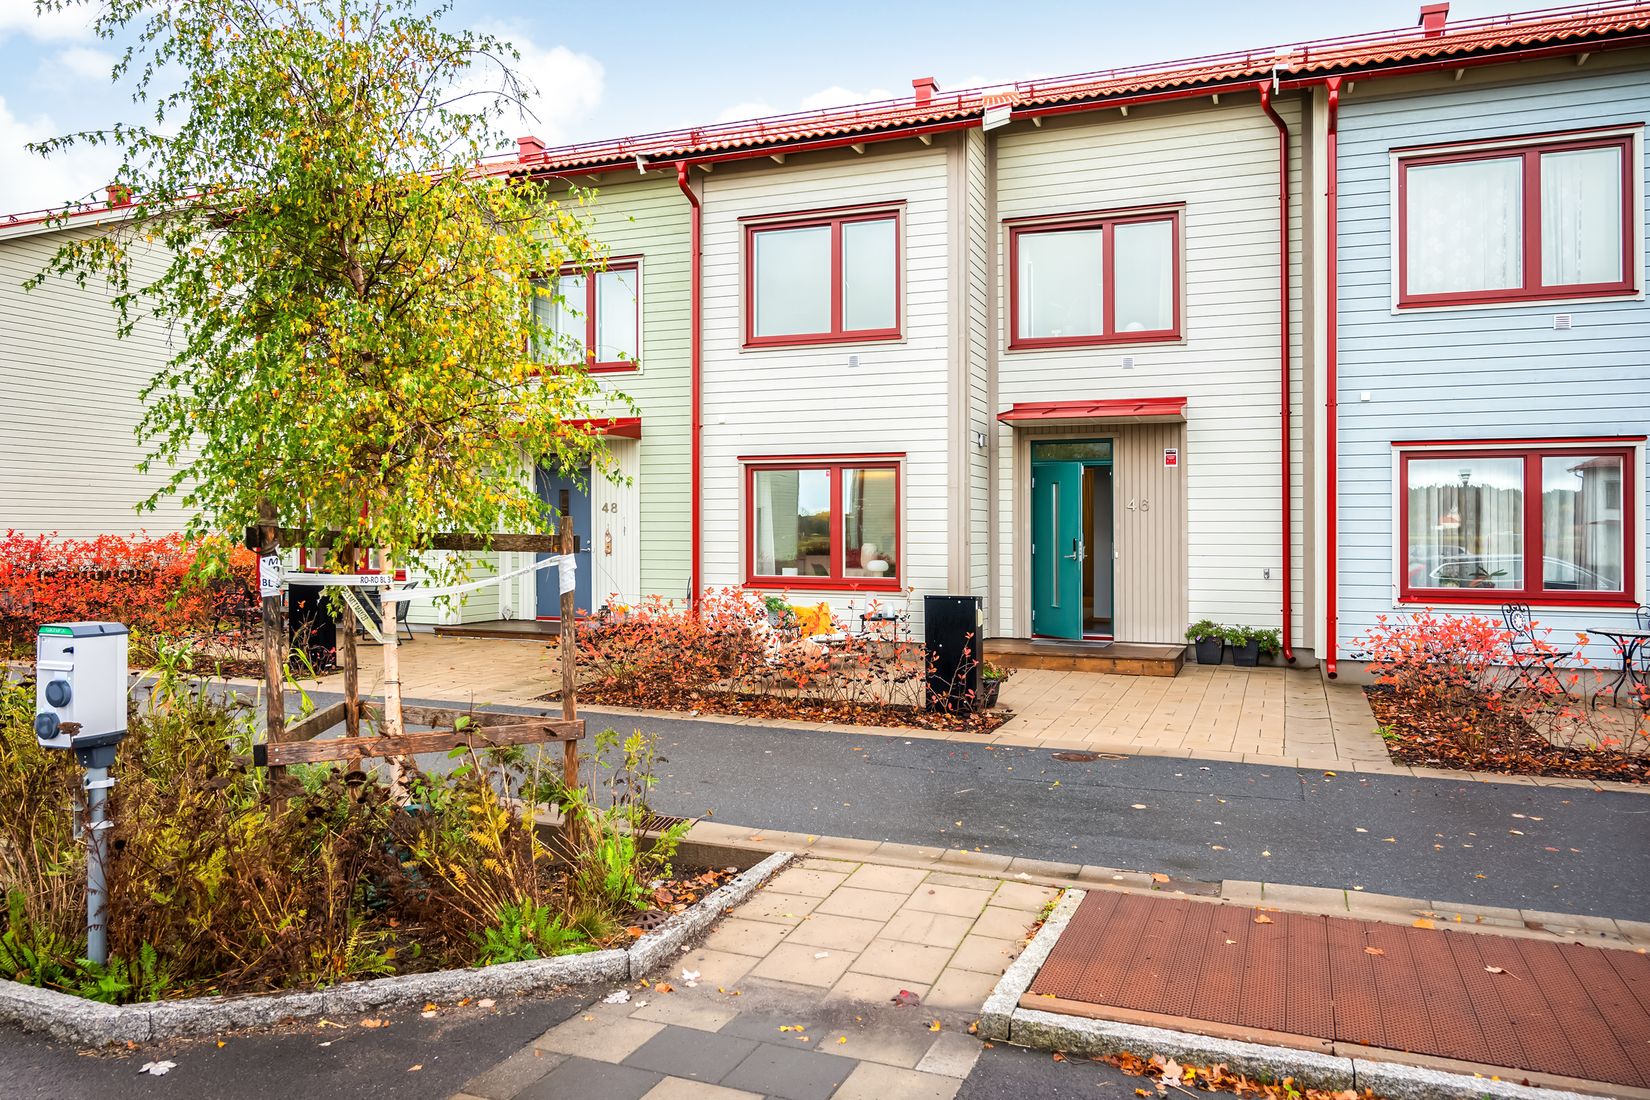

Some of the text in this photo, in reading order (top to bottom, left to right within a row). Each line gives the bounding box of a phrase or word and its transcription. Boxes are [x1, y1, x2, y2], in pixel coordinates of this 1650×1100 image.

[601, 502, 617, 513] 48
[1127, 498, 1149, 512] 46
[262, 578, 273, 588] BL
[360, 576, 379, 584] RO-RO
[380, 576, 386, 584] BL
